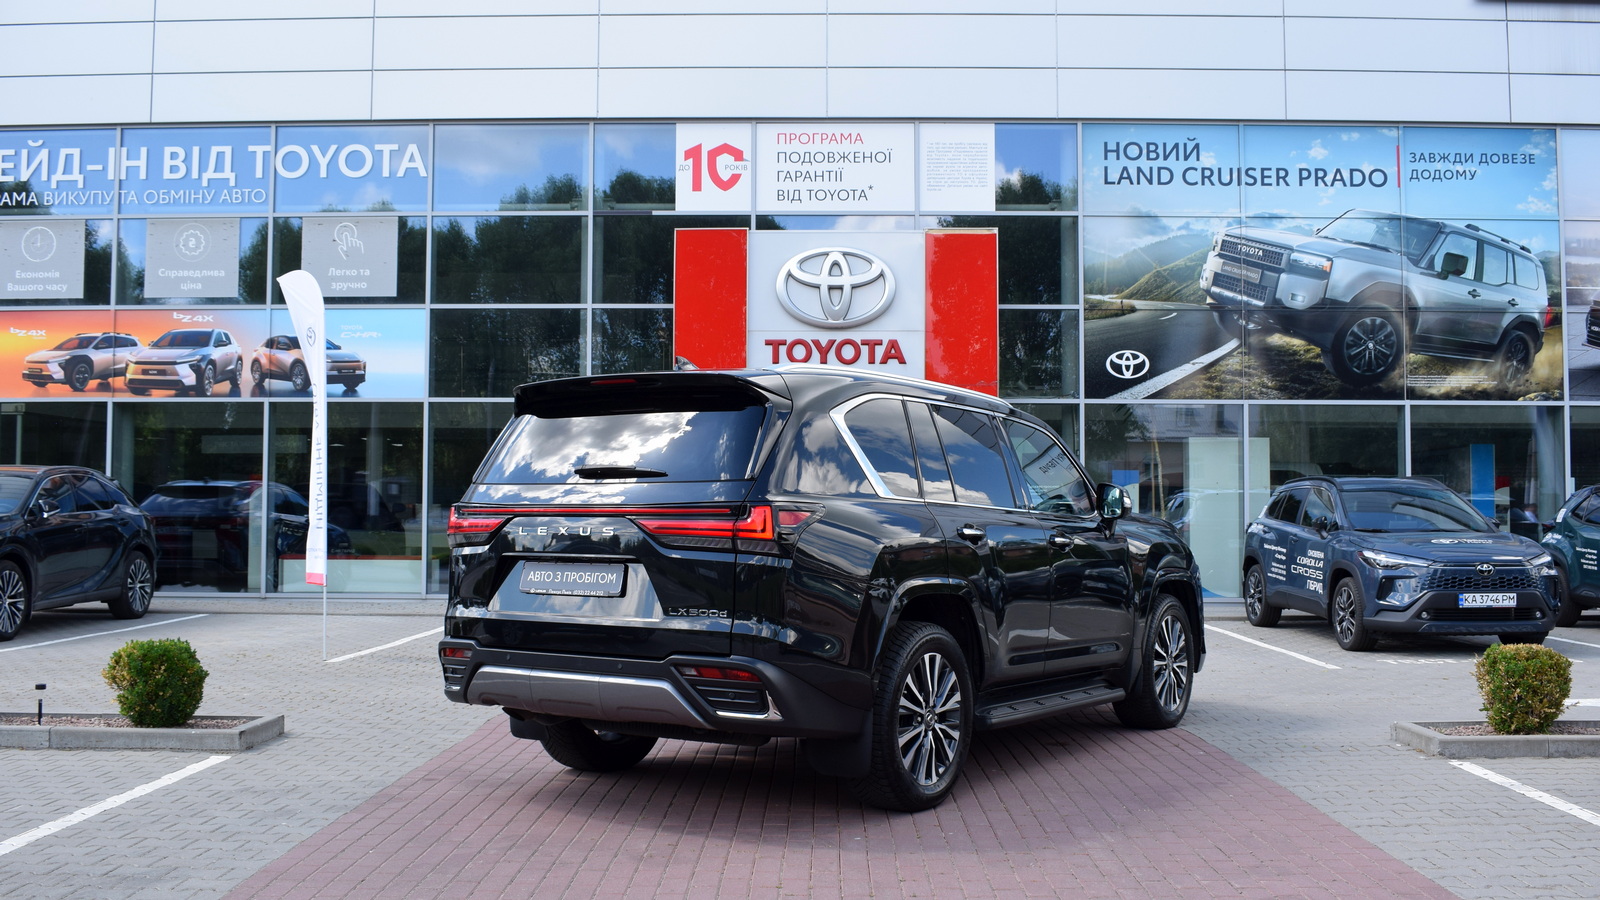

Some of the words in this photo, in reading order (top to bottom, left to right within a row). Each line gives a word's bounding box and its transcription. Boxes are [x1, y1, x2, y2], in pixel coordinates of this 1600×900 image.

[776, 132, 864, 145] ПРОГРАМА
[1103, 137, 1200, 162] НОВИЙ
[776, 149, 892, 166] ПОДОВЖЕНОЇ
[1409, 151, 1475, 166] ЗАВЖДИ
[1478, 153, 1536, 167] ДОВЕЗЕ
[0, 139, 148, 189] ЕЙД-ІН
[163, 145, 236, 187] ВІД
[248, 143, 428, 179] TOYOTA
[724, 163, 748, 171] РОКІВ
[776, 167, 844, 183] ГАРАНТІЇ
[1103, 166, 1174, 186] LAND
[1182, 166, 1290, 187] CRUISER
[1299, 168, 1388, 188] PRADO
[1409, 169, 1477, 183] ДОДОМУ
[0, 191, 39, 207] АМА
[43, 190, 115, 206] ВИКУПУ
[119, 190, 140, 204] ТА
[143, 189, 216, 205] ОБМІНУ
[219, 188, 267, 204] АВТО
[776, 188, 803, 203] ВІД
[1237, 245, 1263, 256] TOYOTA
[15, 270, 61, 279] Економія
[158, 268, 226, 279] Справедлива
[328, 268, 358, 276] Легко
[7, 283, 43, 291] Вашого
[45, 283, 67, 292] часу
[180, 282, 202, 292] ціна
[331, 281, 367, 291] зручно
[765, 339, 906, 364] TOYOTA
[518, 526, 615, 536] LEXUS
[1296, 556, 1324, 568] COROLLA
[527, 571, 553, 582] АВТО
[563, 572, 617, 583] ПРОБІГОМ
[1291, 564, 1323, 580] CROSS
[1480, 595, 1500, 604] 3746
